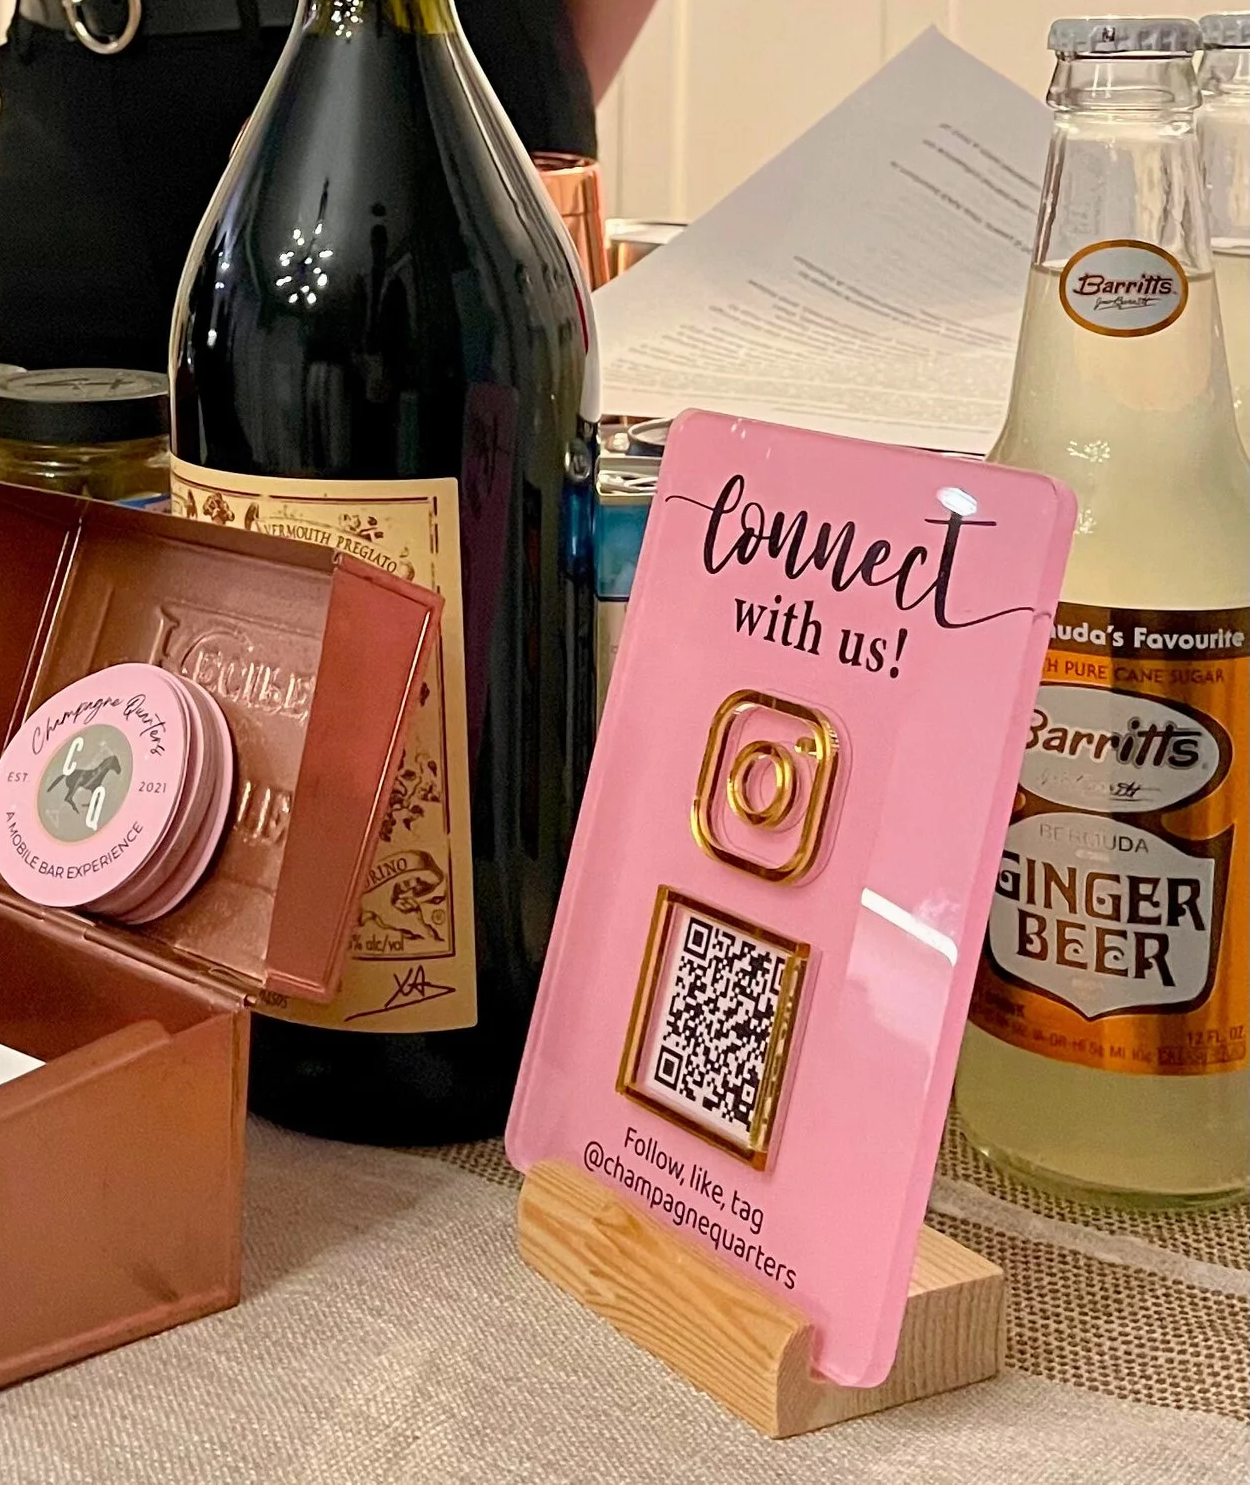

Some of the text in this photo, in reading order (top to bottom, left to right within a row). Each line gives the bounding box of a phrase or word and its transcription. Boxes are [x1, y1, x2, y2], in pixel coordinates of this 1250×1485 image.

[1072, 271, 1174, 296] Barritts
[263, 523, 398, 574] VERMOUTH PREGIATO
[734, 594, 909, 680] with us!
[1051, 621, 1246, 651] uda's Favourite
[1064, 661, 1108, 681] PURE
[1114, 666, 1165, 683] CANE
[1169, 668, 1226, 685] SUGAR
[30, 693, 167, 757] Champagne Quarters
[1026, 707, 1203, 767] Barritts
[137, 780, 167, 794] 2021
[7, 821, 40, 870] MOBILE
[37, 861, 64, 880] BAR
[66, 820, 144, 880] EXPERIENCE
[1039, 822, 1150, 854] BERMUDA
[364, 857, 408, 889] RINO
[994, 849, 1206, 932] GINGER
[365, 933, 405, 953] alc/vol
[1016, 908, 1176, 988] BEER
[624, 1126, 765, 1235] Follow, like, tag
[583, 1140, 797, 1291] @champagnequarters
